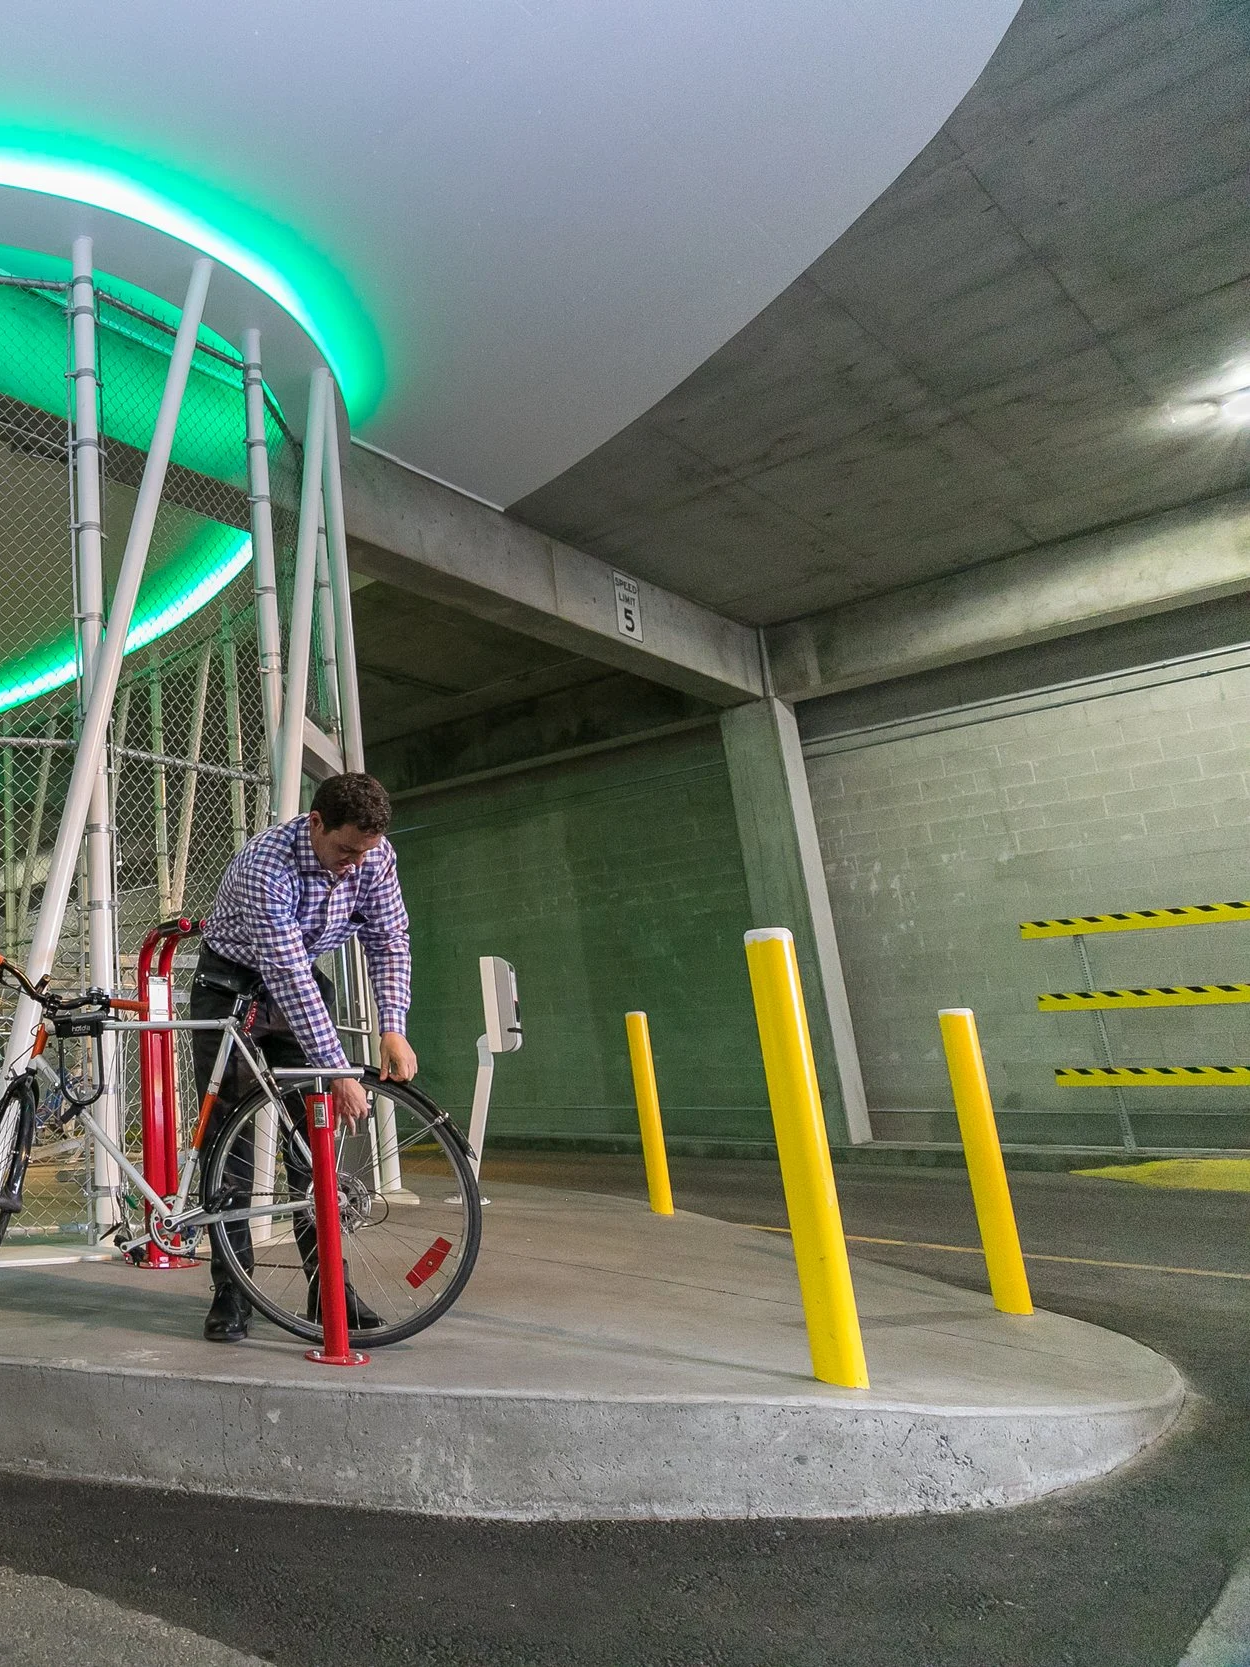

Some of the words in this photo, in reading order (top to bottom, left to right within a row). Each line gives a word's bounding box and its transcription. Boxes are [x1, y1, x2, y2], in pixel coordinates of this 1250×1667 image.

[615, 577, 637, 594] SPEED
[619, 592, 635, 607] LIMIT
[624, 608, 635, 632] 5
